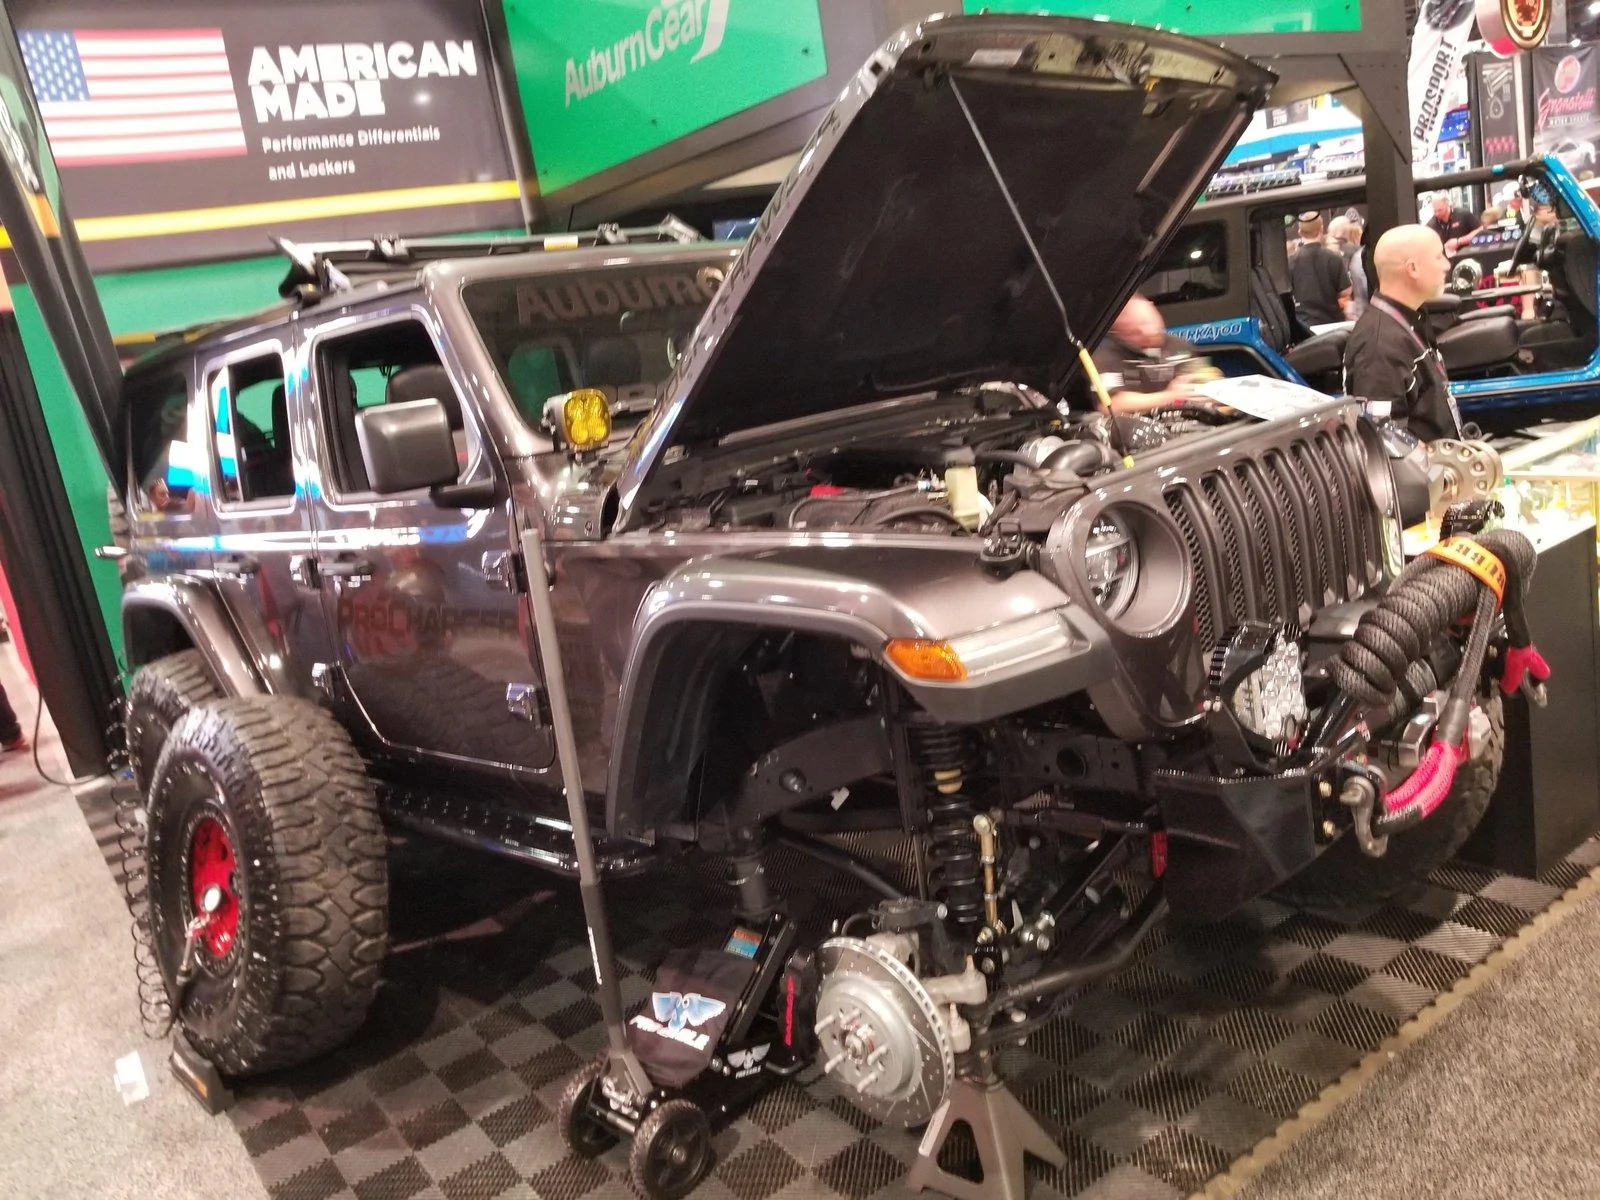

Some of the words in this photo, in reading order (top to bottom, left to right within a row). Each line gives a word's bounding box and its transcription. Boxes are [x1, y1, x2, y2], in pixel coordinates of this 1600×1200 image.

[247, 40, 477, 86] AMERICAN
[250, 79, 386, 123] MADE
[1413, 36, 1456, 143] PROSPORT
[262, 133, 354, 154] Performance
[357, 124, 441, 147] Differentials
[268, 162, 296, 181] and
[299, 158, 356, 178] Lockers
